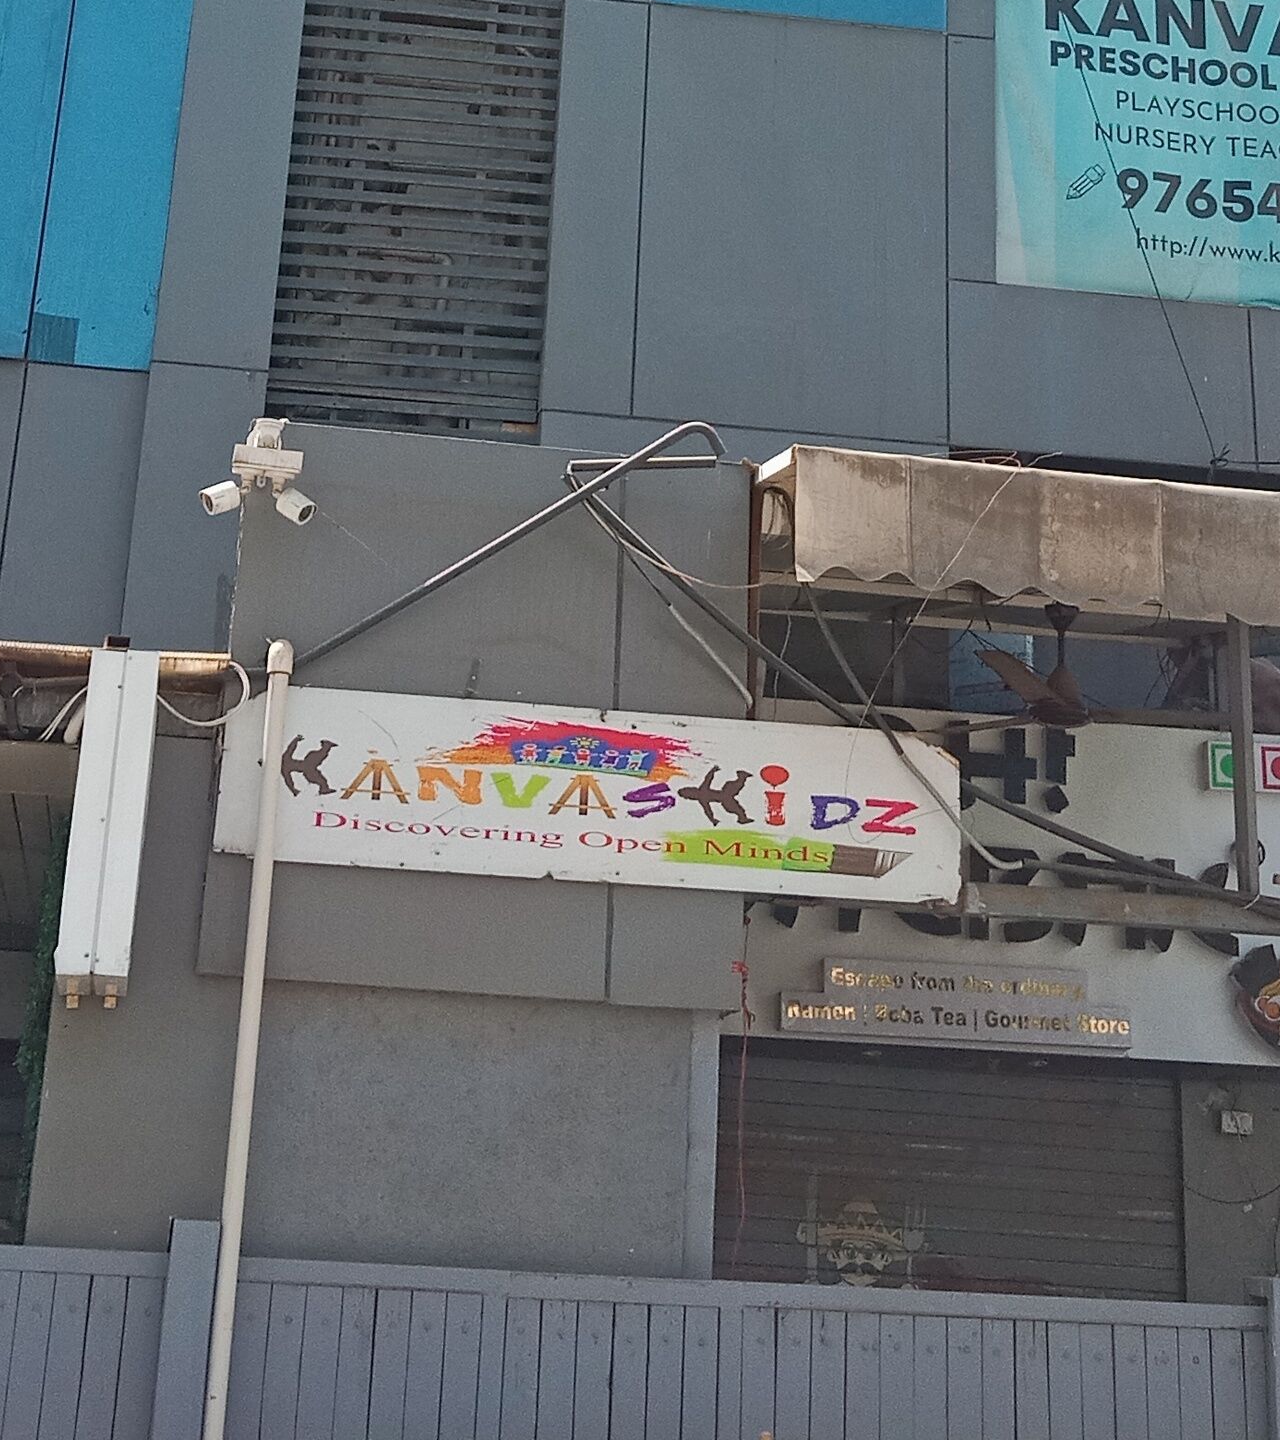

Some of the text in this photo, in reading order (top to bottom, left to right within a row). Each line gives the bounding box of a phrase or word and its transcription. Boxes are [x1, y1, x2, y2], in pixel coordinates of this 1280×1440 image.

[1050, 39, 1278, 93] PRESCHOOL
[1094, 123, 1216, 158] NURSERY
[311, 810, 828, 864] Discovering Open Minds
[910, 972, 956, 992] from
[786, 1001, 856, 1021] Ramen
[931, 1007, 967, 1027] Tea
[1077, 1014, 1131, 1036] Store
